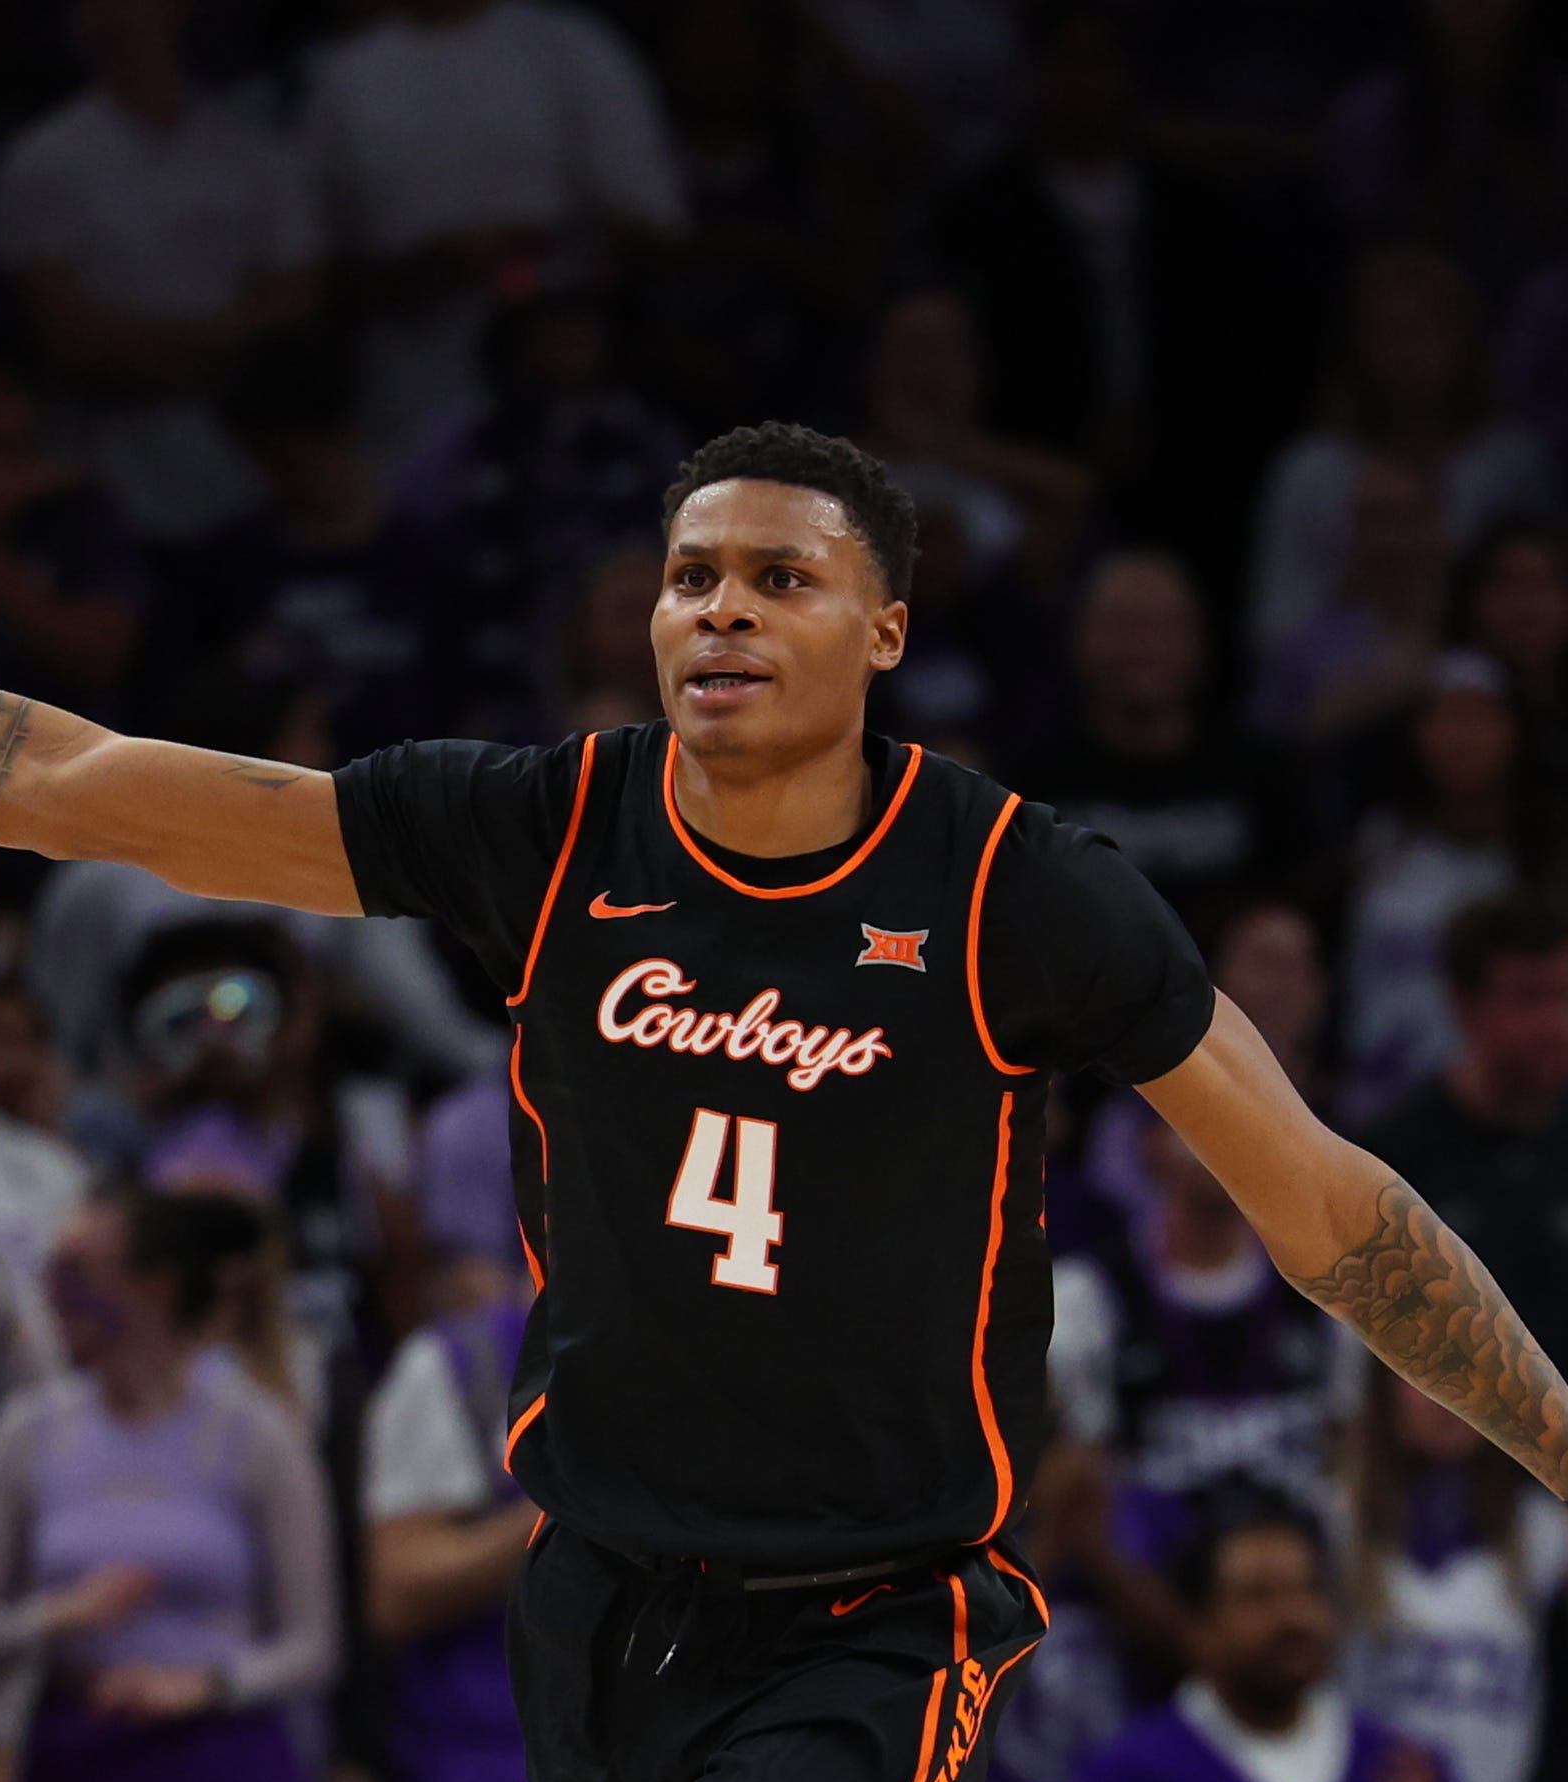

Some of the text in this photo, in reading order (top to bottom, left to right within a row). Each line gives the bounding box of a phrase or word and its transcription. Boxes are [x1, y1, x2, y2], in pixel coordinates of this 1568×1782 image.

[861, 927, 925, 969] XII
[596, 957, 893, 1093] Cowboys
[664, 1106, 786, 1296] 4
